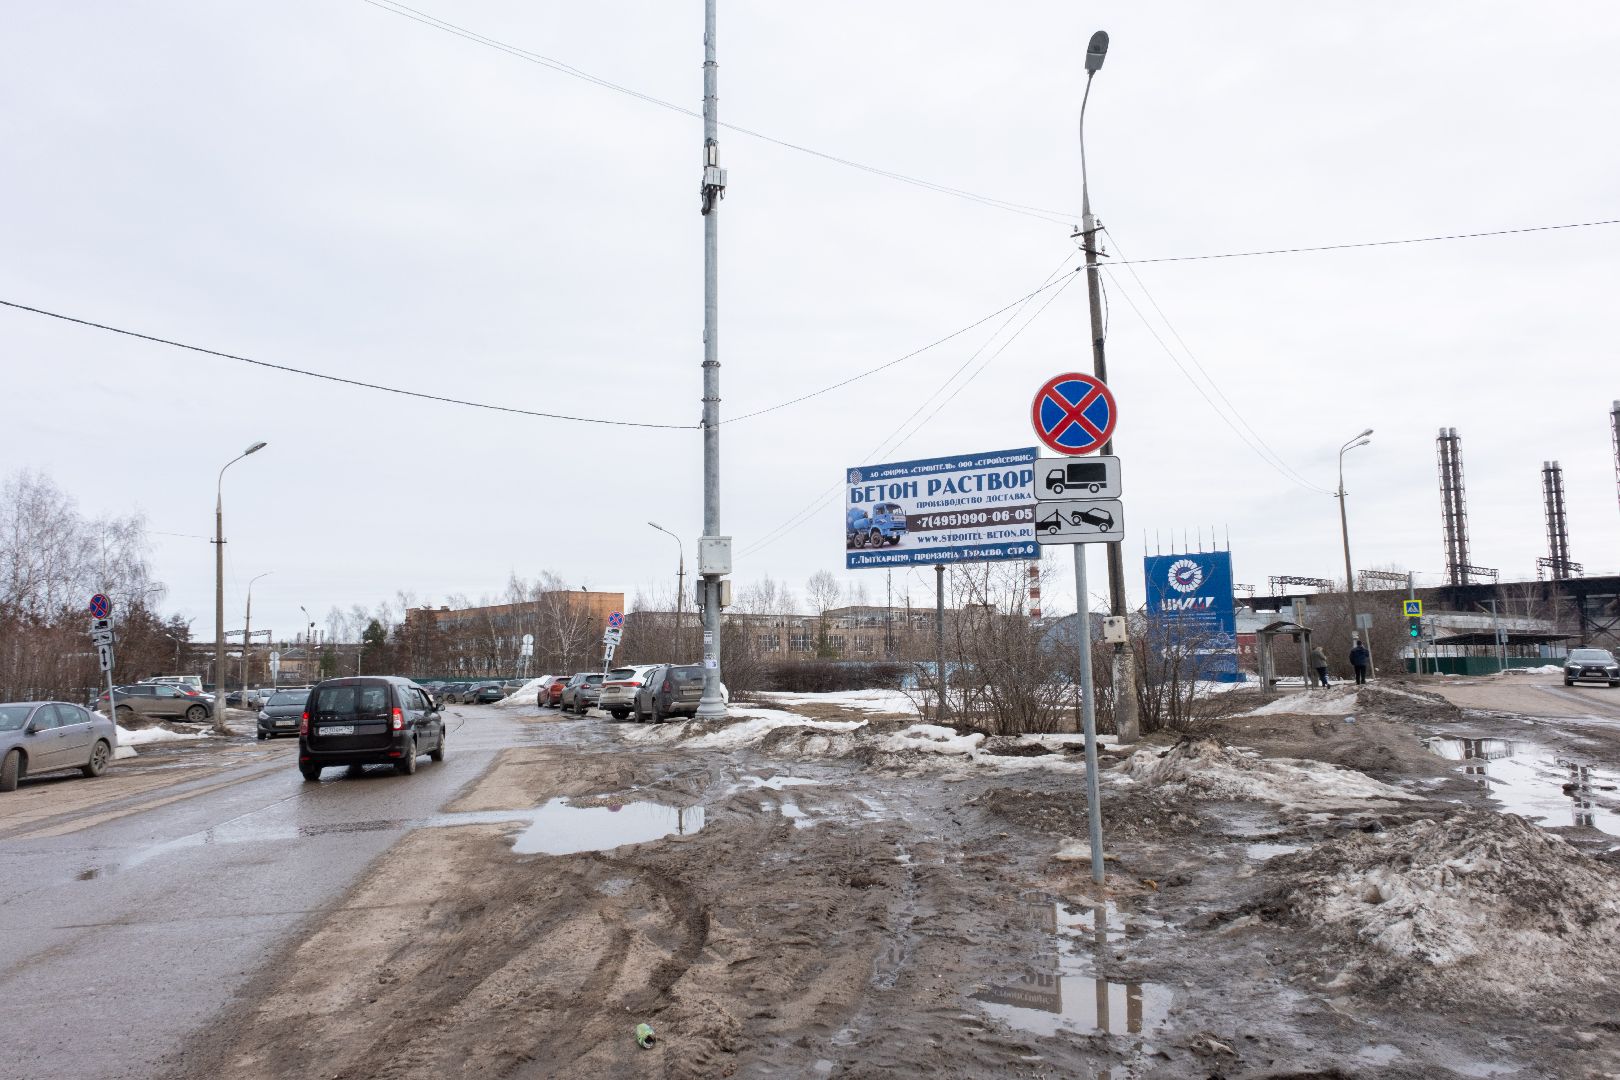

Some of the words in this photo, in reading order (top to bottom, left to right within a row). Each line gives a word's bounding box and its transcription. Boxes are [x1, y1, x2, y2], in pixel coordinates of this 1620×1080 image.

[958, 460, 973, 468] ООО
[851, 480, 918, 504] БЕТОН
[928, 469, 1033, 497] РАСТВОР
[916, 496, 983, 509] ПРОИЗВОДСТВО
[986, 492, 1032, 504] ДОСТАВКА
[916, 508, 1034, 528] +7(495)990-06-05
